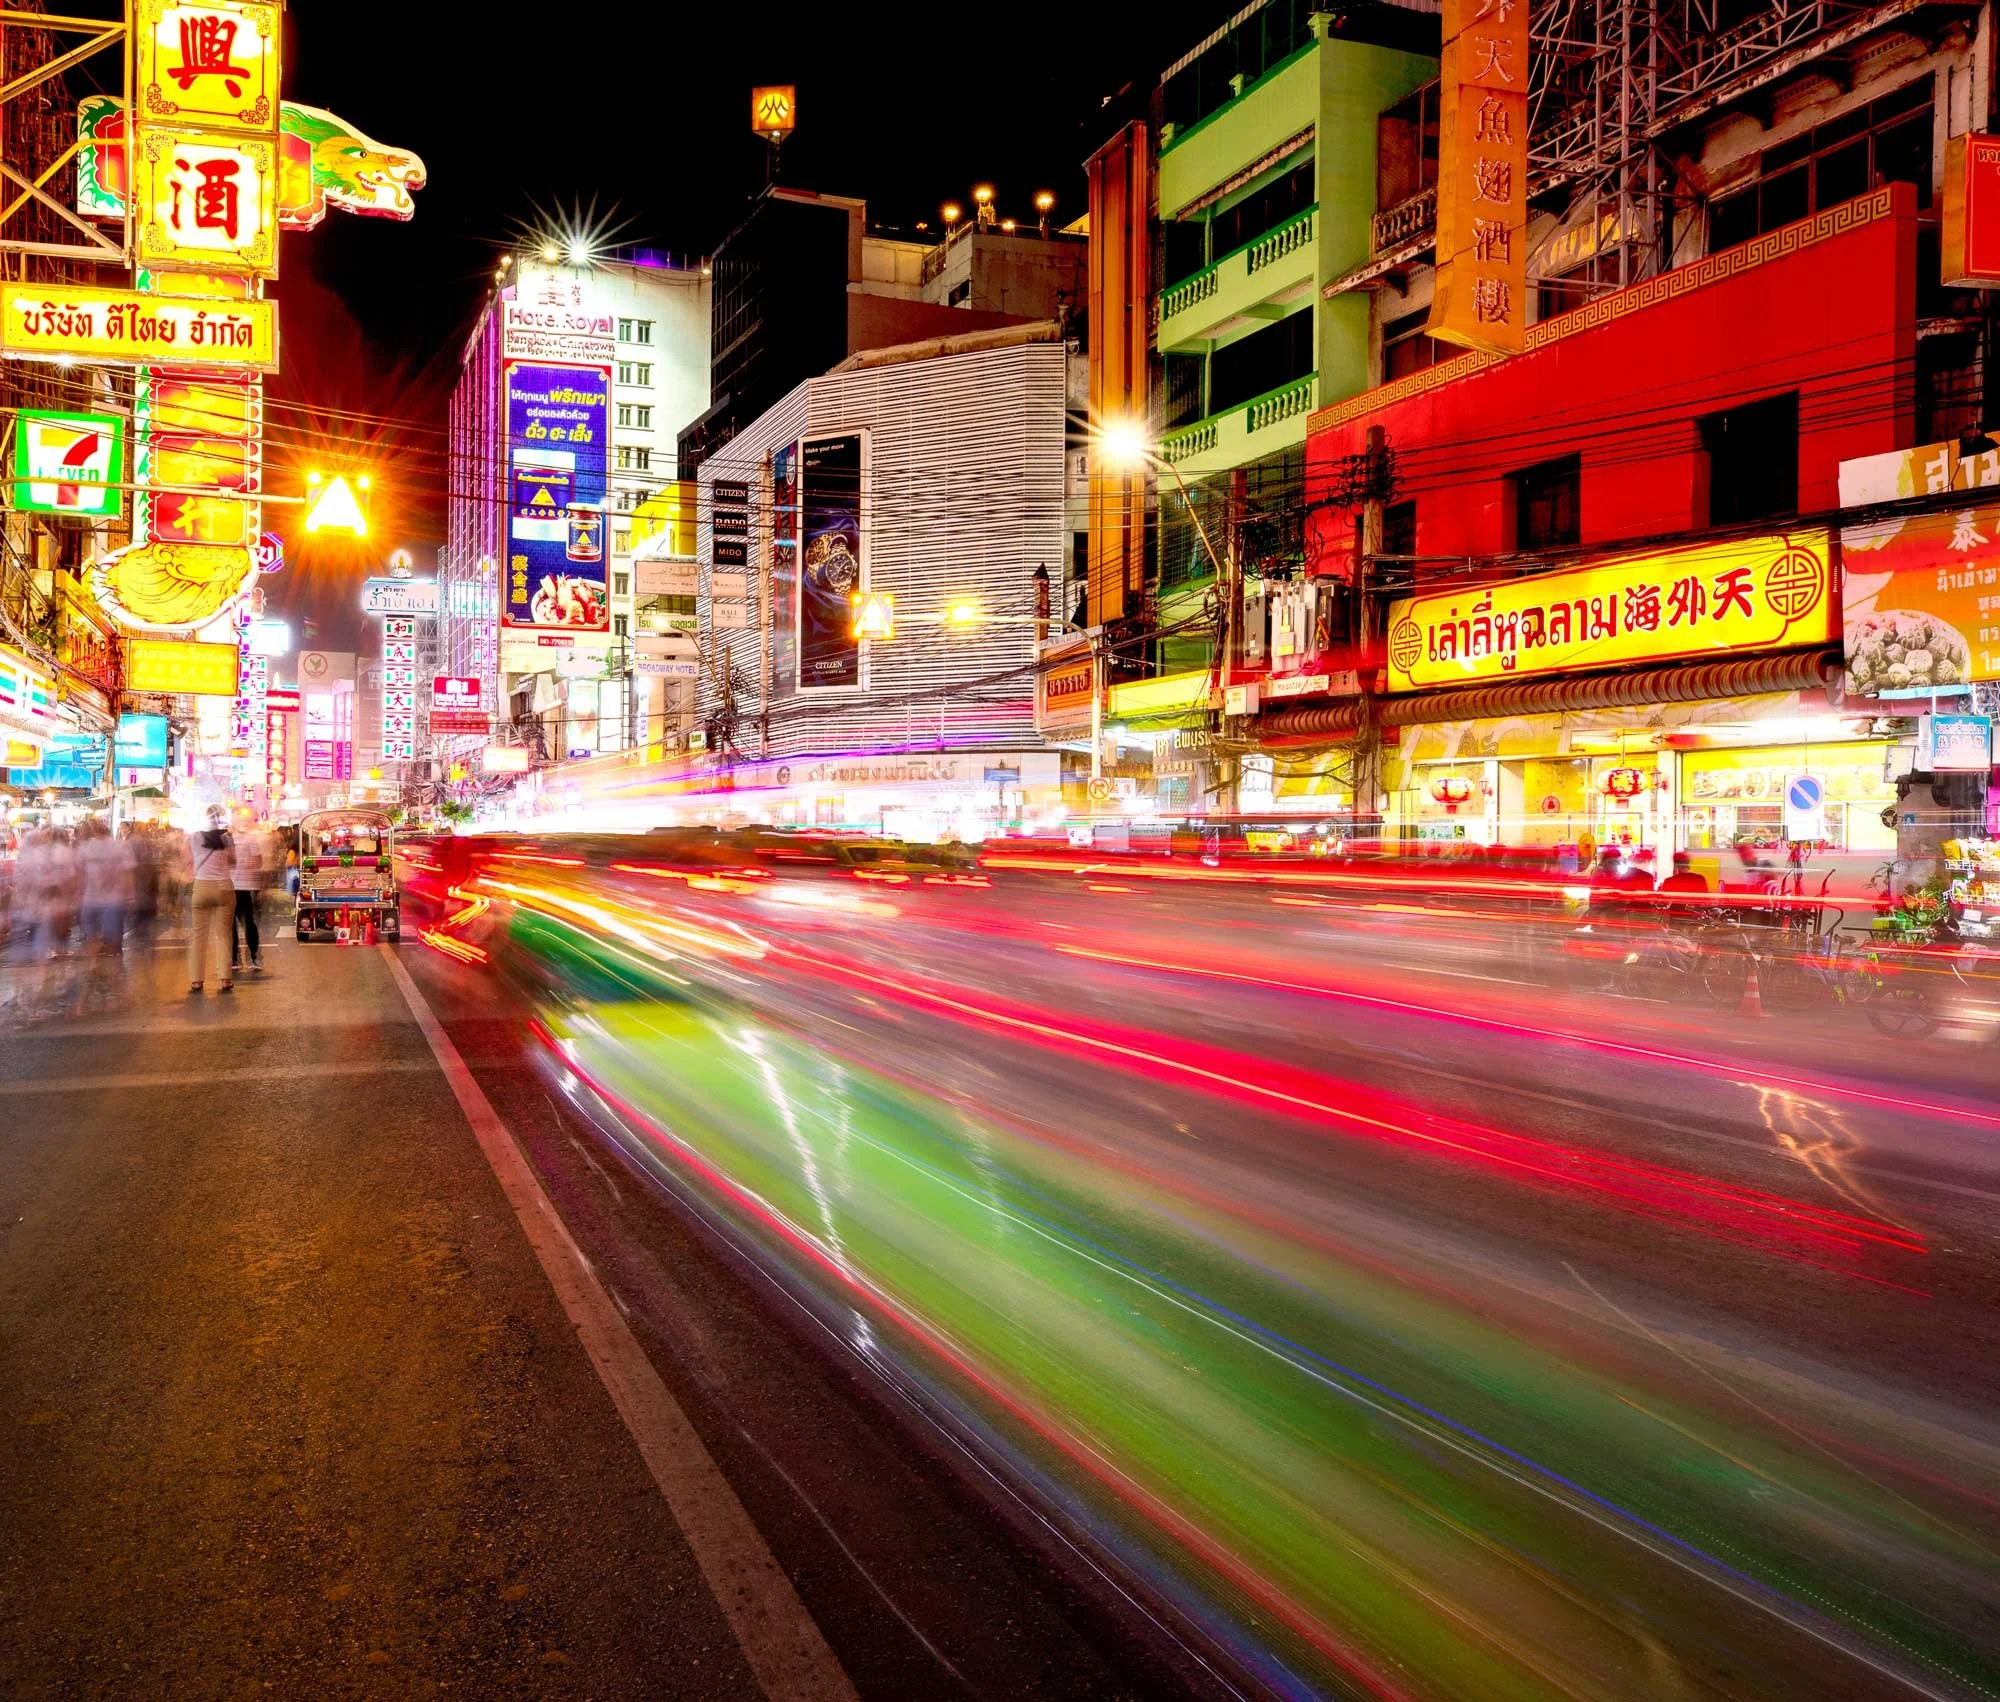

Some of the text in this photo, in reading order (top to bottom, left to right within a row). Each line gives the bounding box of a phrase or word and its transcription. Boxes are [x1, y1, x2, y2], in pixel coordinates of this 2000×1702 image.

[23, 301, 253, 348] บริษัท ดีไทย จำกัด
[509, 307, 614, 334] Hote Royal
[715, 488, 746, 497] CITIZEN
[718, 548, 742, 557] MIDO
[1428, 567, 1755, 671] เล่าลี่หูฉลาม 海外天
[637, 662, 697, 674] BROADWAY HOTEL
[815, 660, 843, 669] CITIZEN
